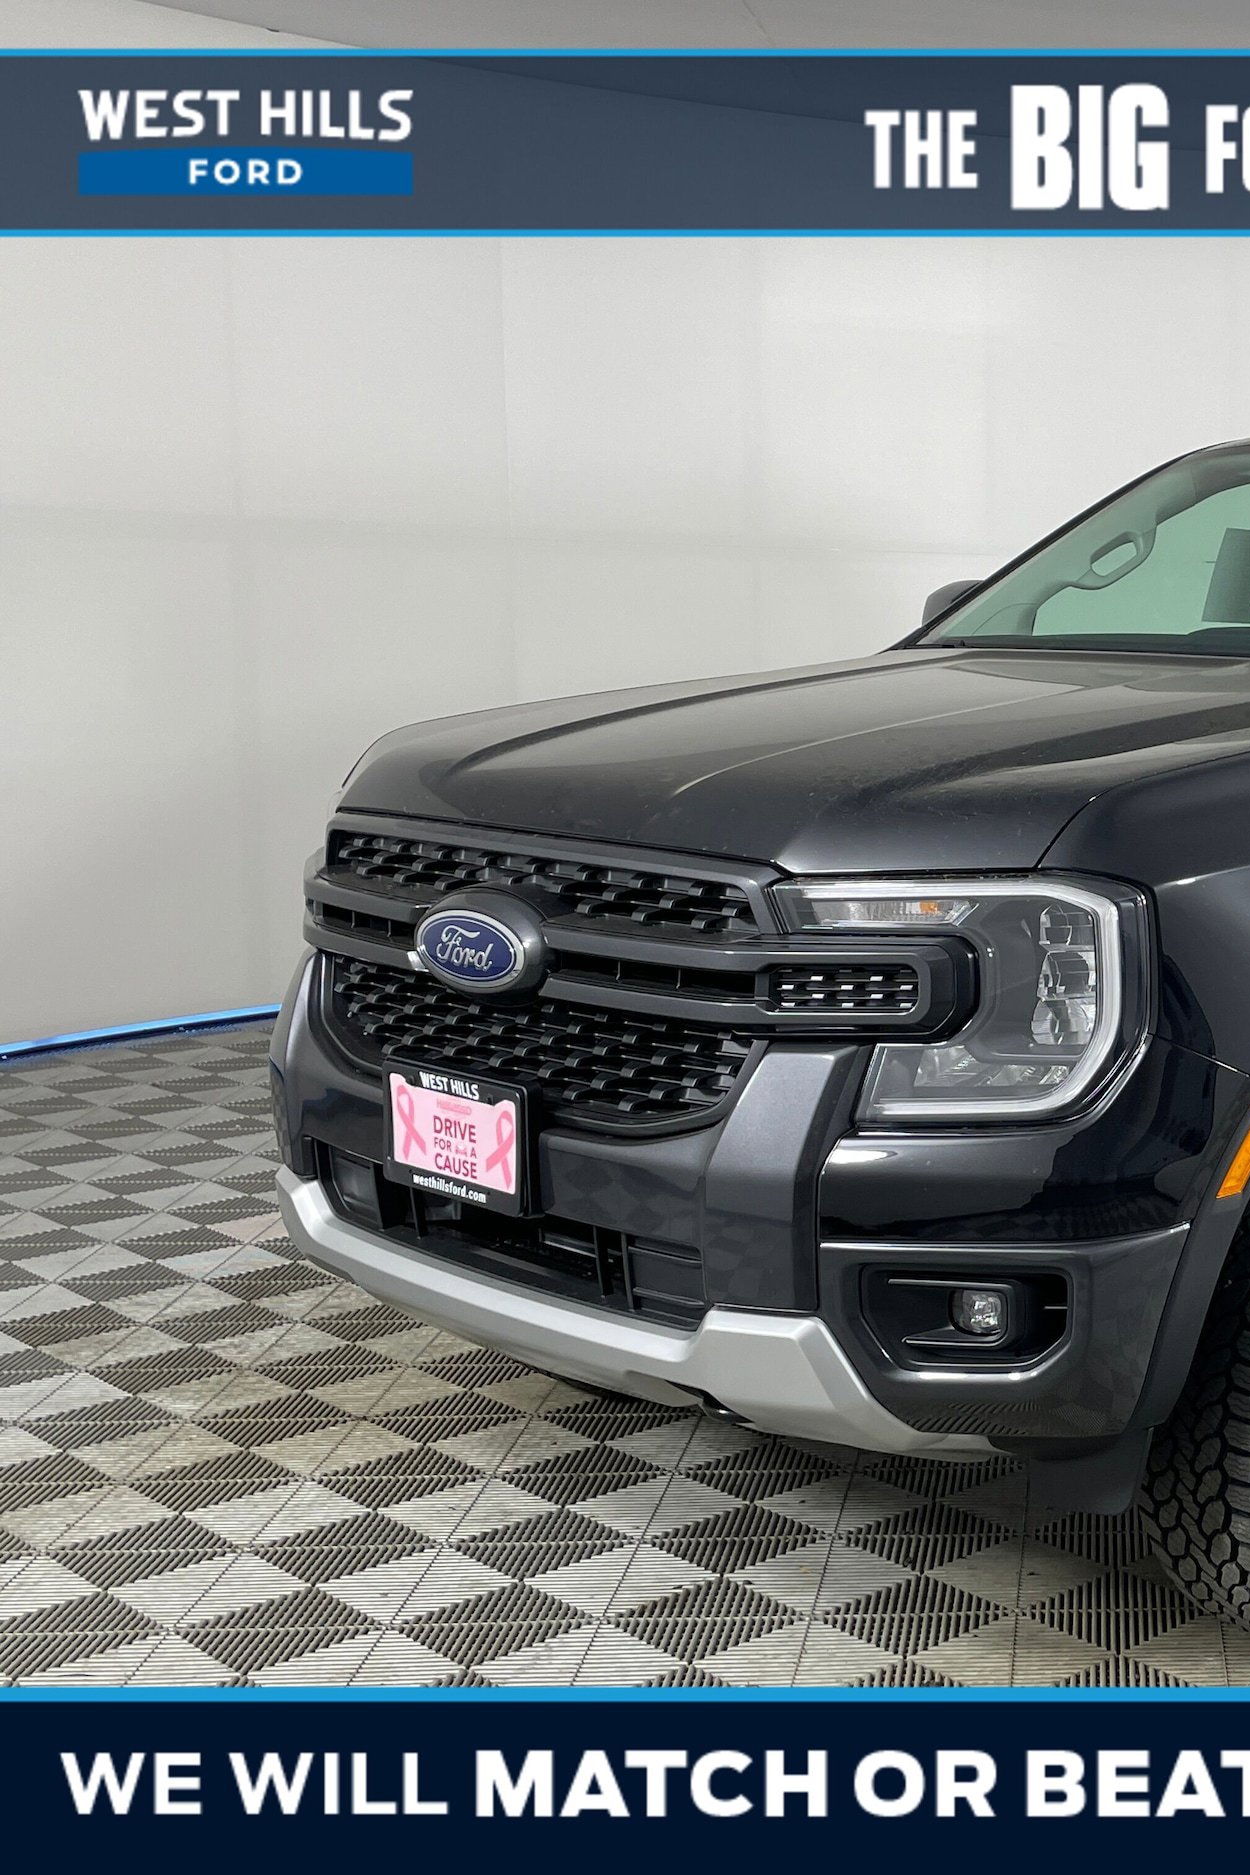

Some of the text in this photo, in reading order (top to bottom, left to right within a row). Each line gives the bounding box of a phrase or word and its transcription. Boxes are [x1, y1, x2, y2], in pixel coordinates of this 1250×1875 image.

[436, 925, 494, 971] Ford
[419, 1071, 480, 1101] WEST HILLS
[433, 1115, 477, 1144] DRIVE
[433, 1137, 478, 1159] FOR A
[434, 1153, 478, 1180] CAUSE
[412, 1174, 487, 1204] westhillsford.com
